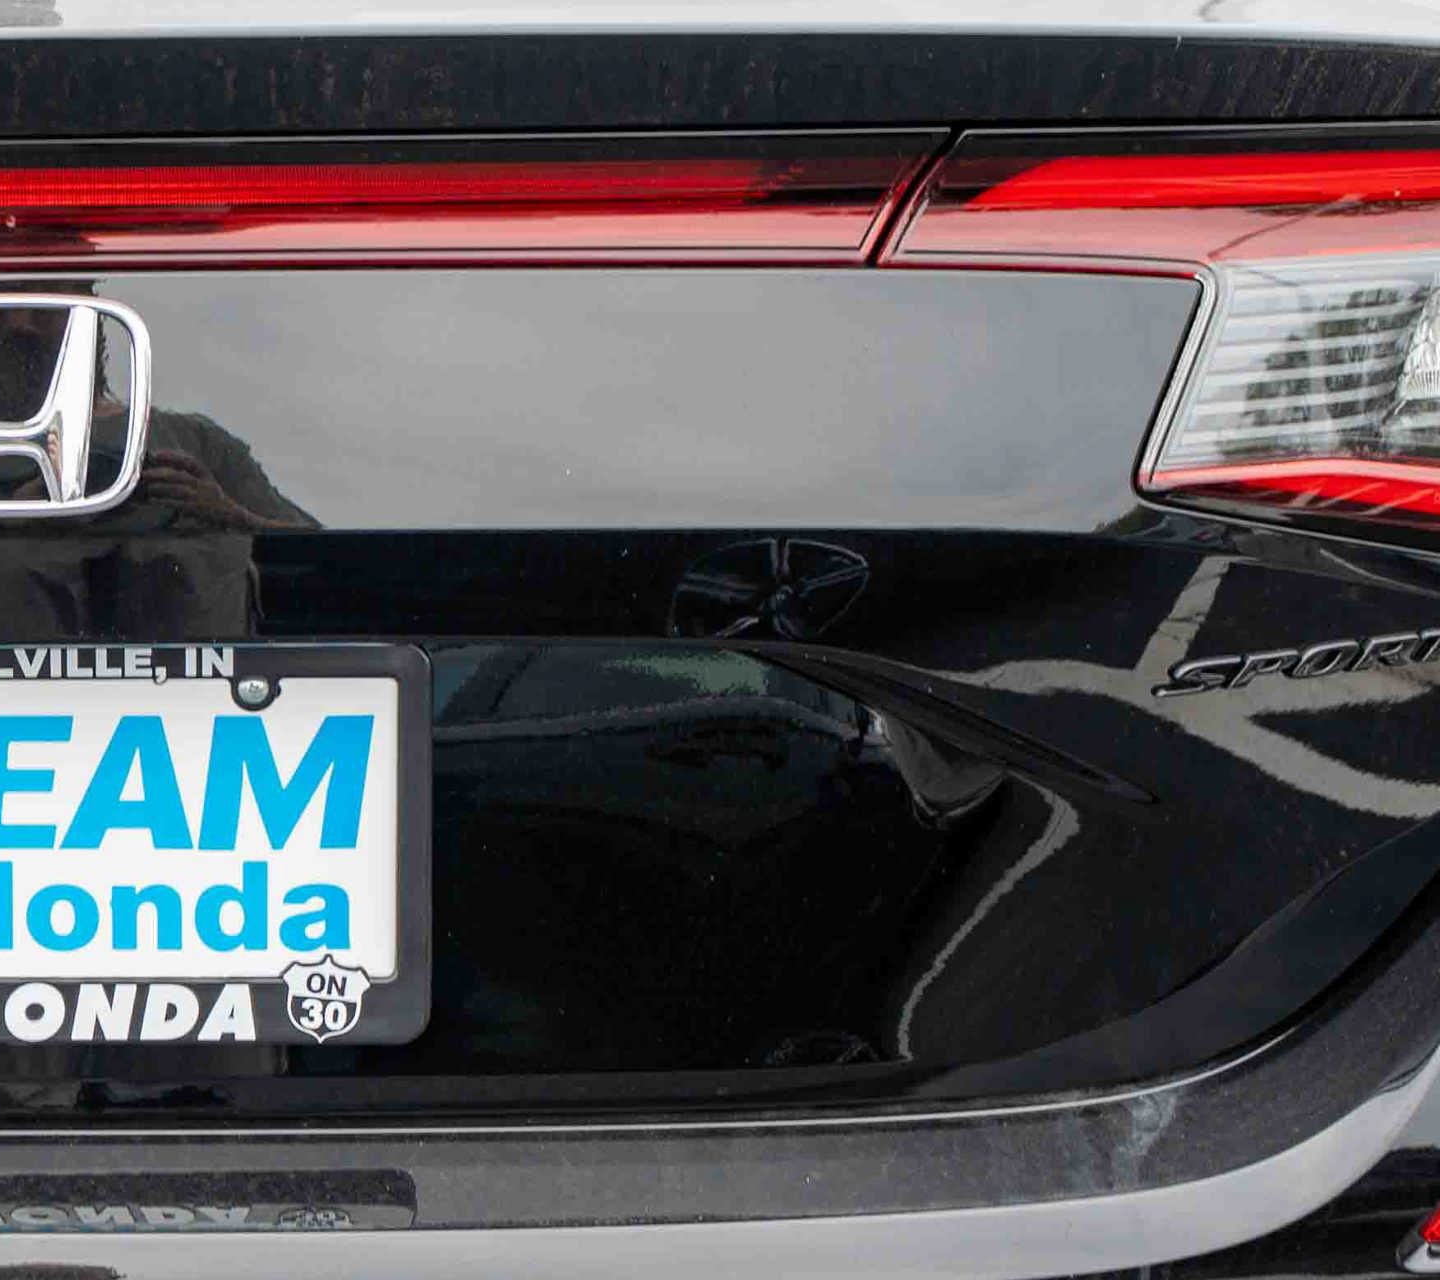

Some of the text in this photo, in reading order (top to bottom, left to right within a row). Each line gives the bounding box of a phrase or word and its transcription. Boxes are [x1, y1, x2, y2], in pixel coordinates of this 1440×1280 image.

[185, 647, 234, 677] IN
[306, 973, 347, 997] ON
[300, 998, 347, 1031] 30
